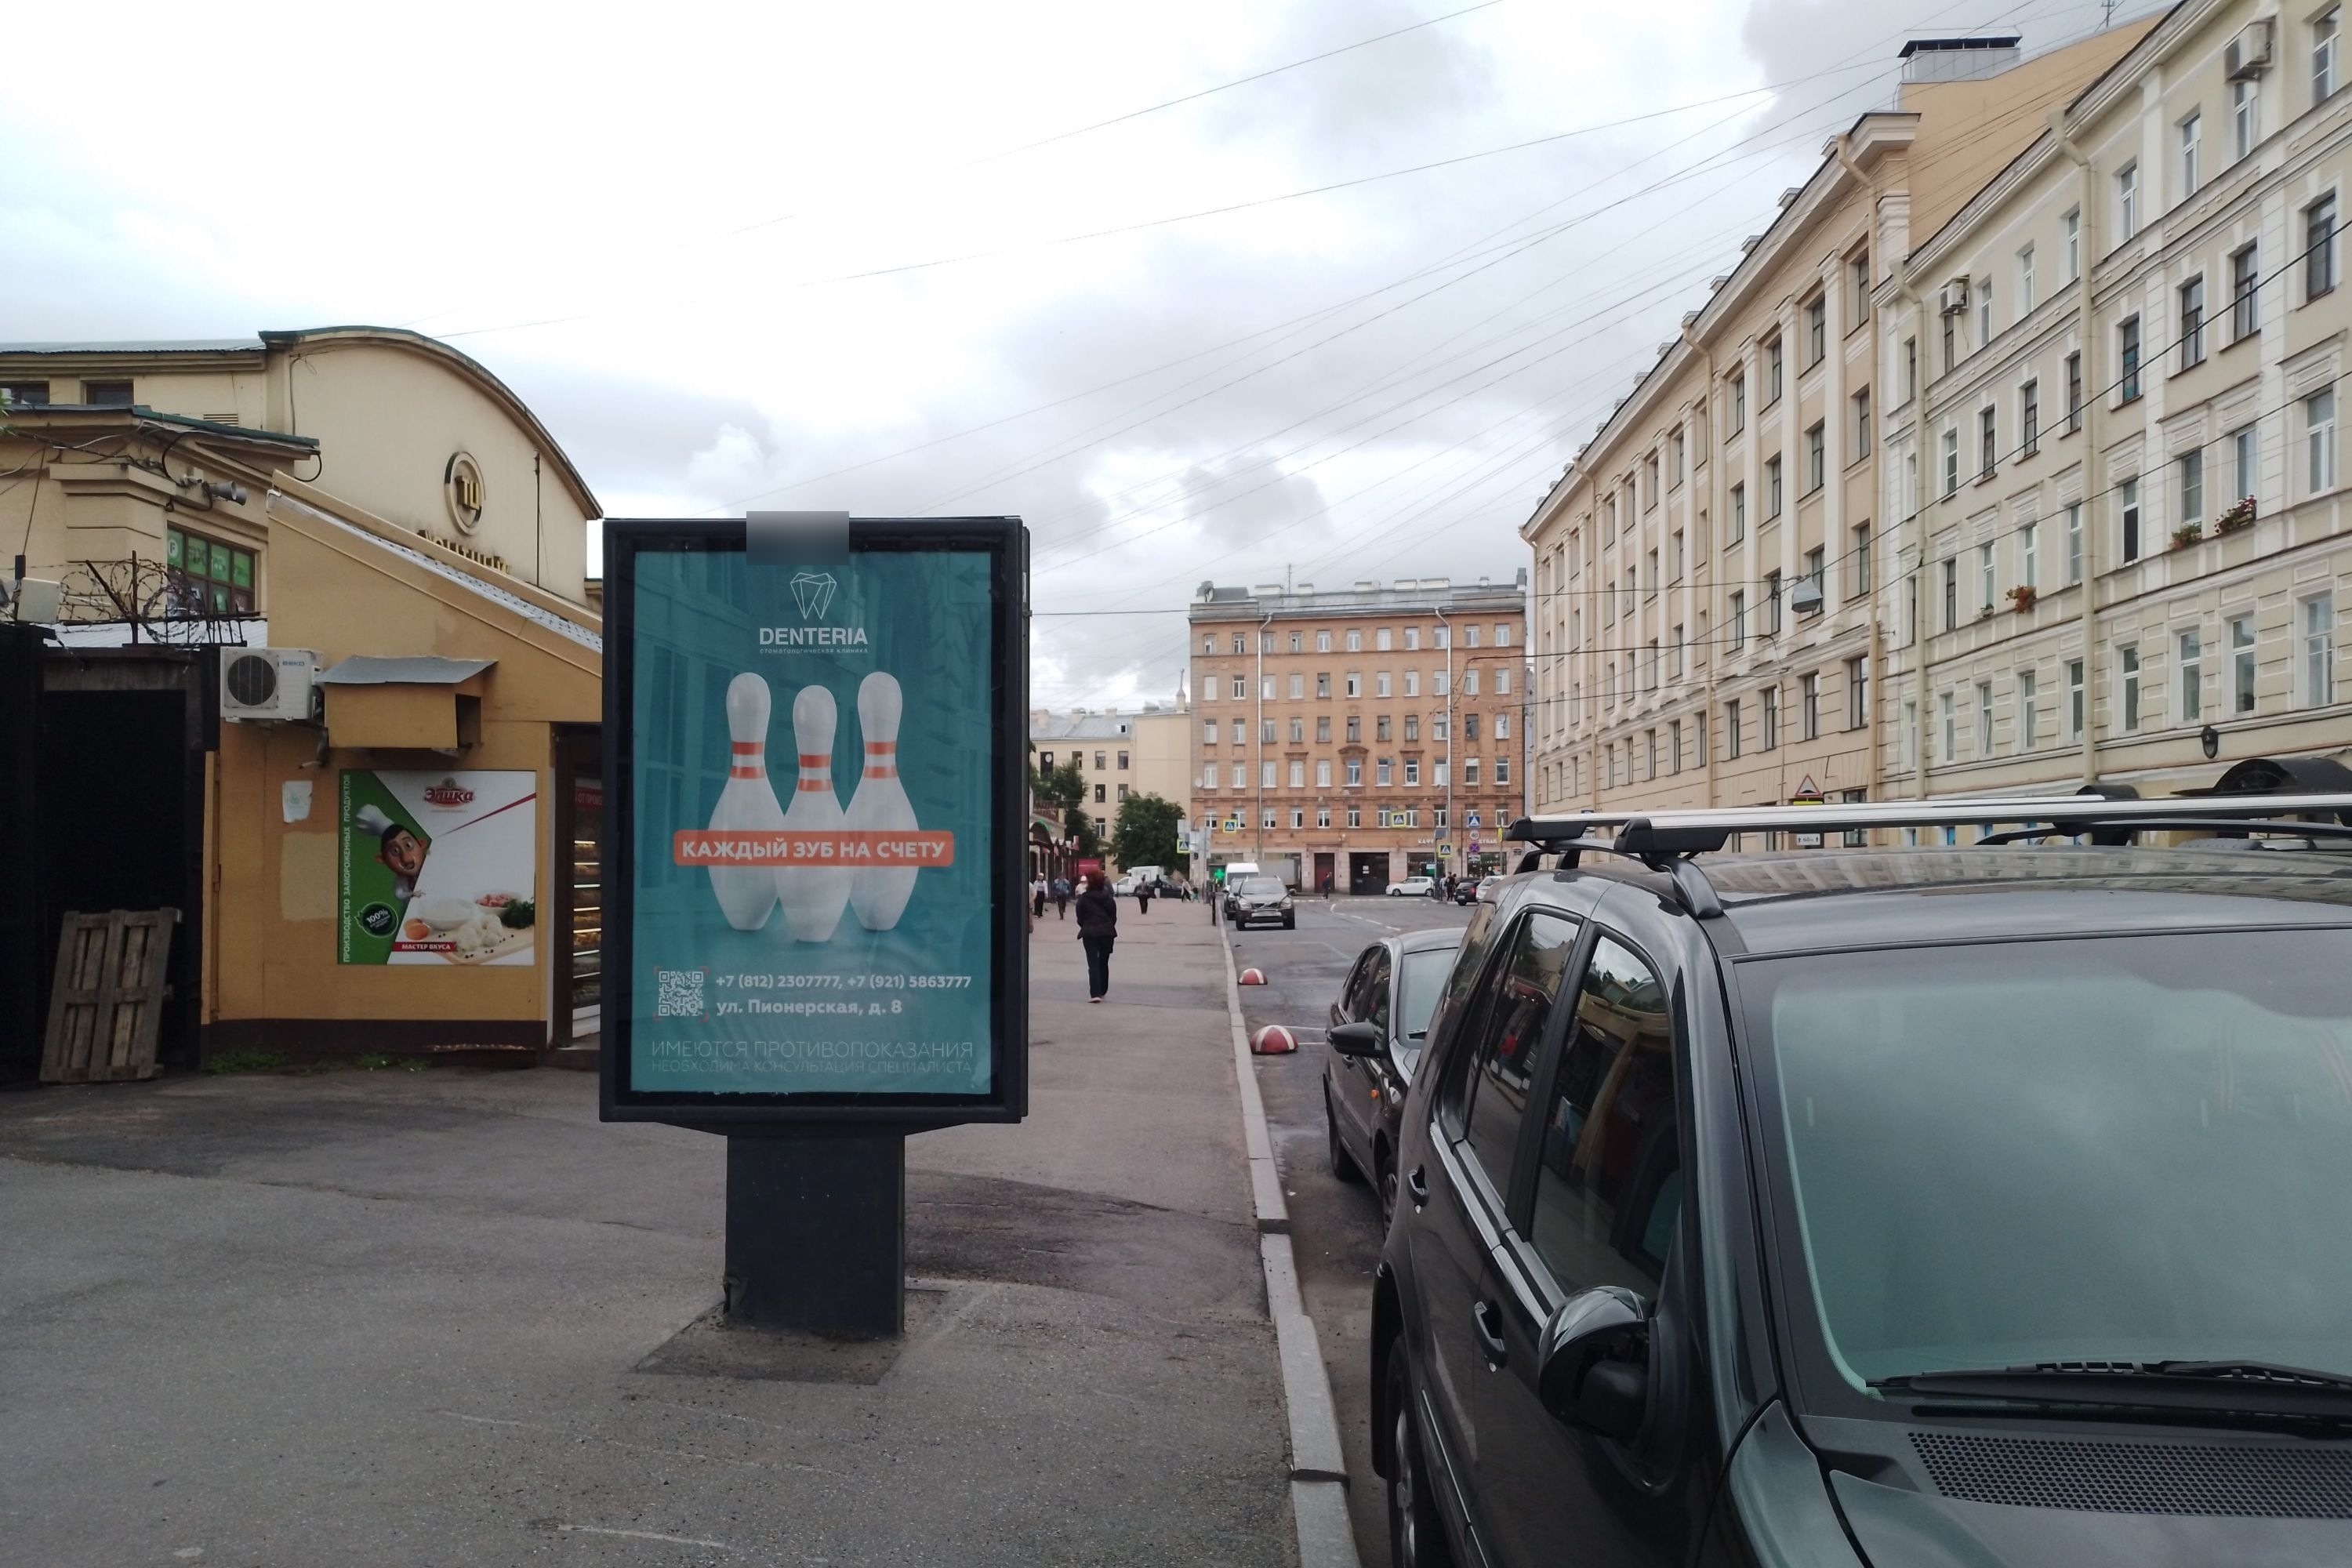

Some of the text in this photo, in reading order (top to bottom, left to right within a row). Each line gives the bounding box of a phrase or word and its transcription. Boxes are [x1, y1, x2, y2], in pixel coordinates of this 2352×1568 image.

[759, 627, 869, 645] DENTERIA
[682, 837, 946, 860] КАЖДЫЙ ЗУБ НА СЧЕТУ
[366, 909, 389, 924] 100%
[716, 974, 971, 989] +7 (812) 2307777, +7 (921) 5863777
[717, 999, 902, 1017] ул. Пионерская, д. 8
[652, 1040, 973, 1058] ИМЕЮТСЯ ПРОТИВОПОКАЗАНИЯ
[652, 1060, 972, 1074] НЕОБХОДИМА КОНСУЛЬТАЦИЯ СПЕЦИАЛИСТА
